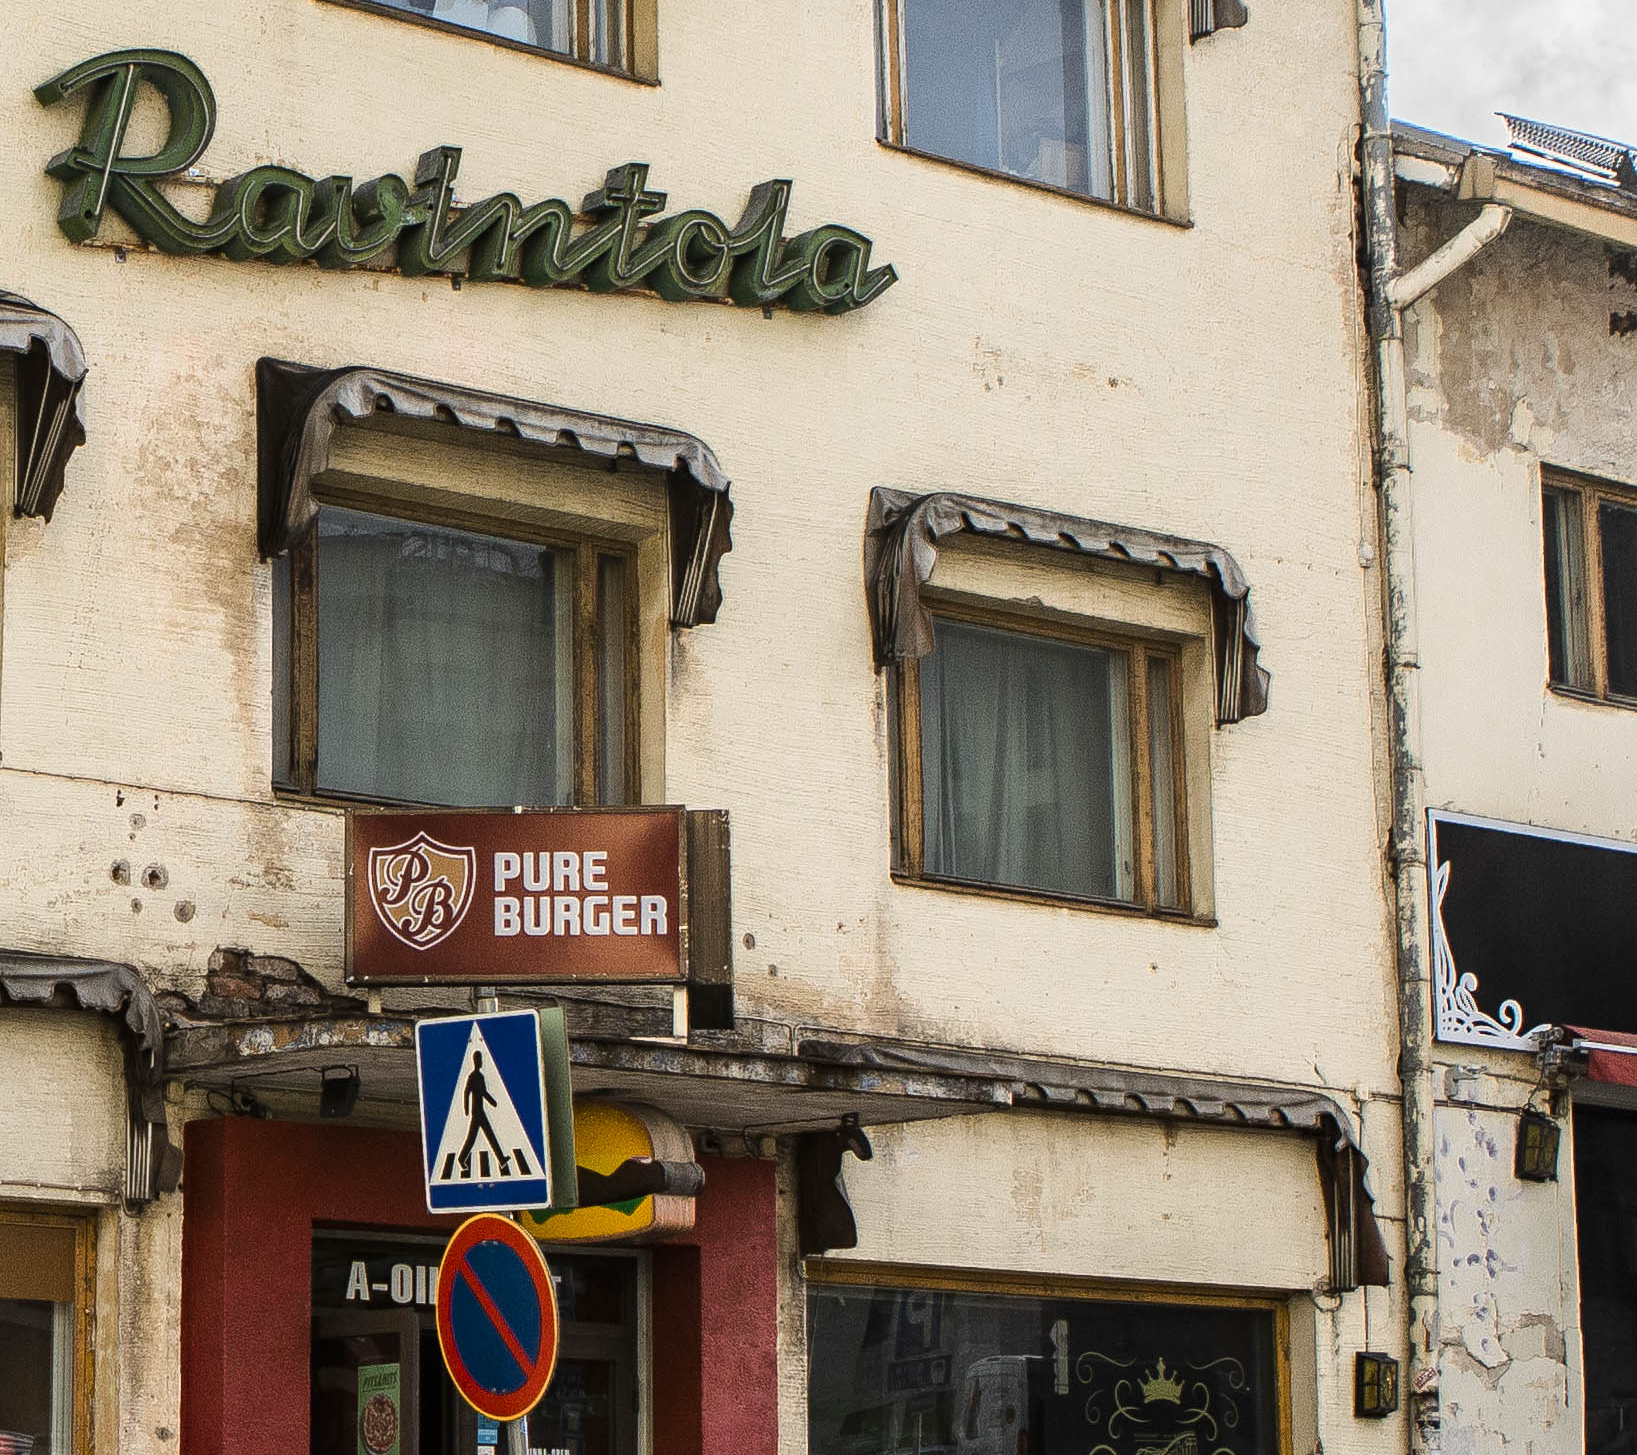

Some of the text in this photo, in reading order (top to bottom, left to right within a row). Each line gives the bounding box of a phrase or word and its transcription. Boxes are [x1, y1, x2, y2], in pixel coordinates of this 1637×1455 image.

[33, 47, 897, 316] Ravintola
[494, 851, 608, 892] PURE
[494, 895, 668, 937] BURGER
